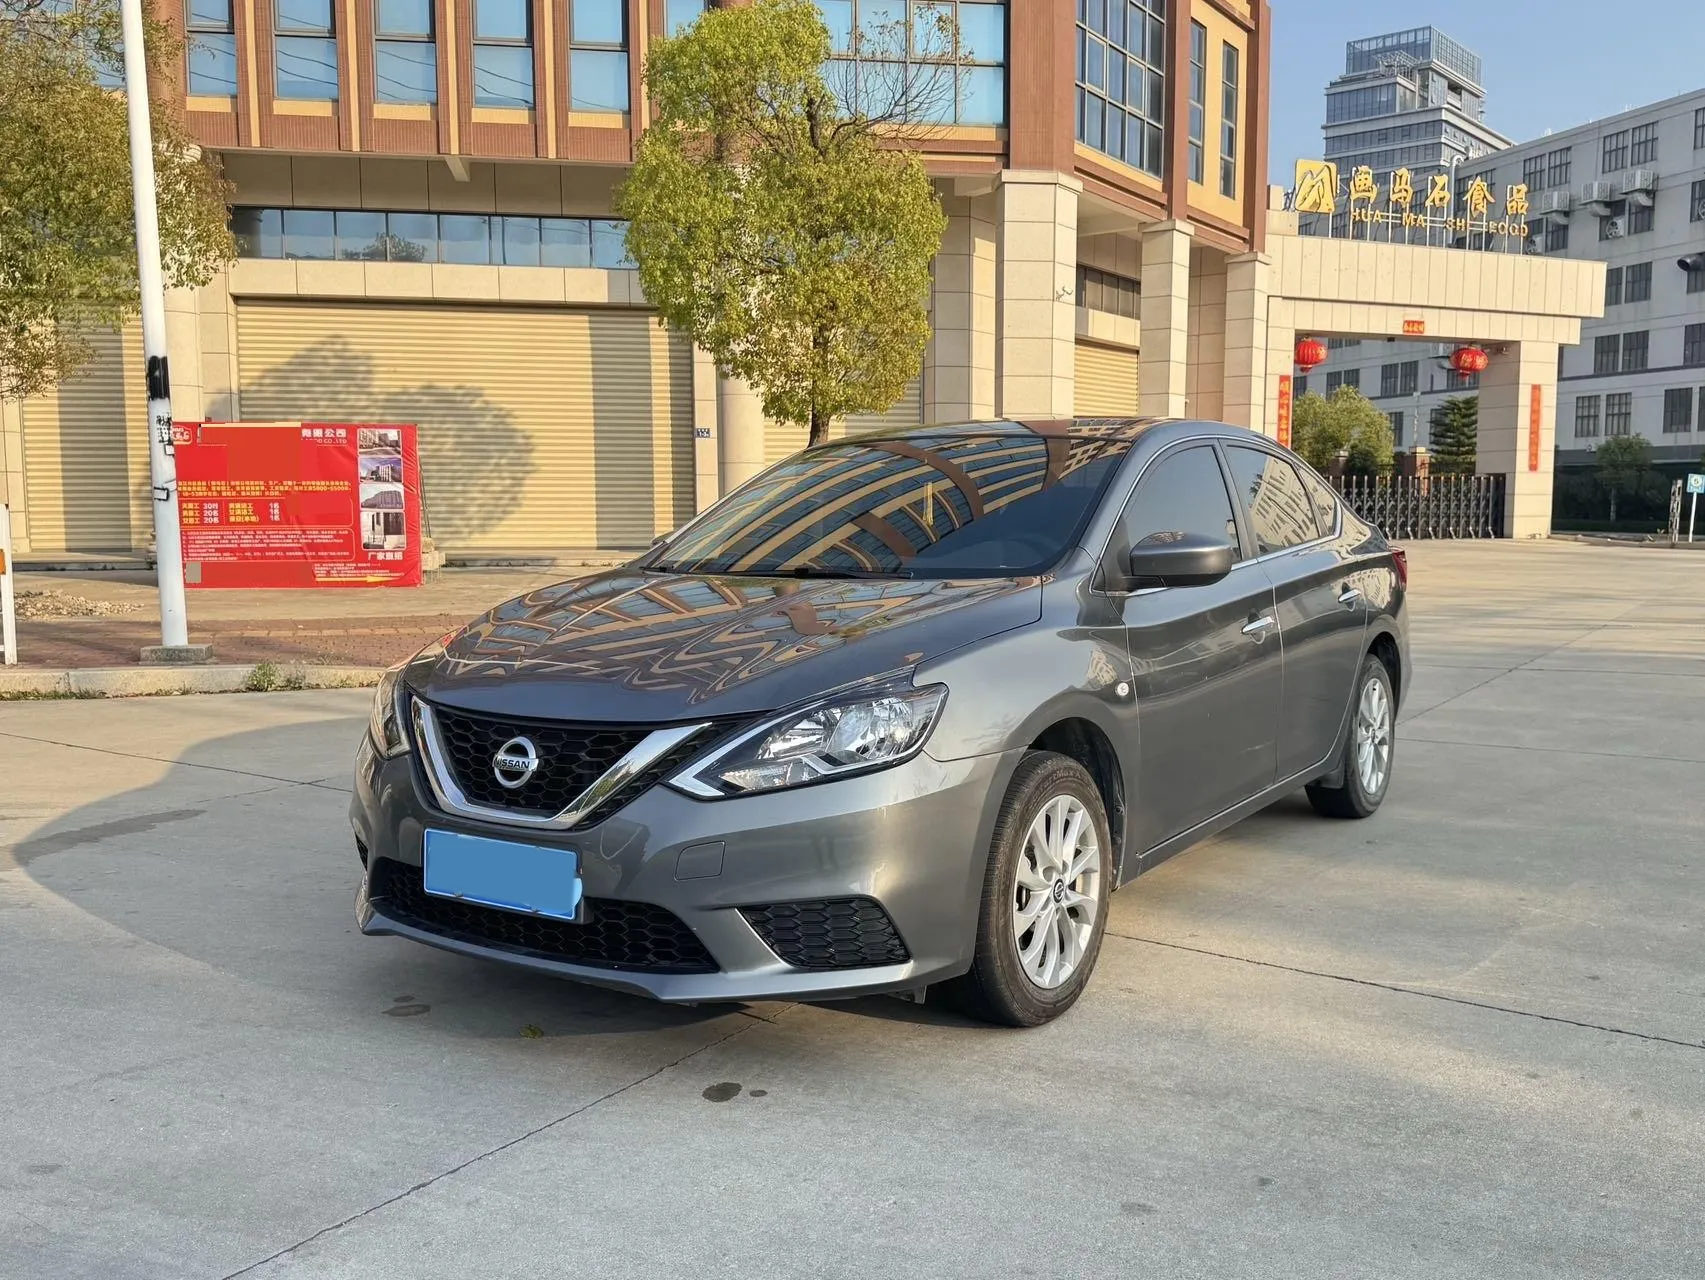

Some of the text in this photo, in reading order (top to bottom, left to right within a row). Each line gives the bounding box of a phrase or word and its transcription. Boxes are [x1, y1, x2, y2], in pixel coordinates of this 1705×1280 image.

[1351, 207, 1382, 223] HUA
[1402, 212, 1426, 228] MA
[1489, 221, 1528, 236] FOOD
[495, 756, 530, 769] NISSAN
